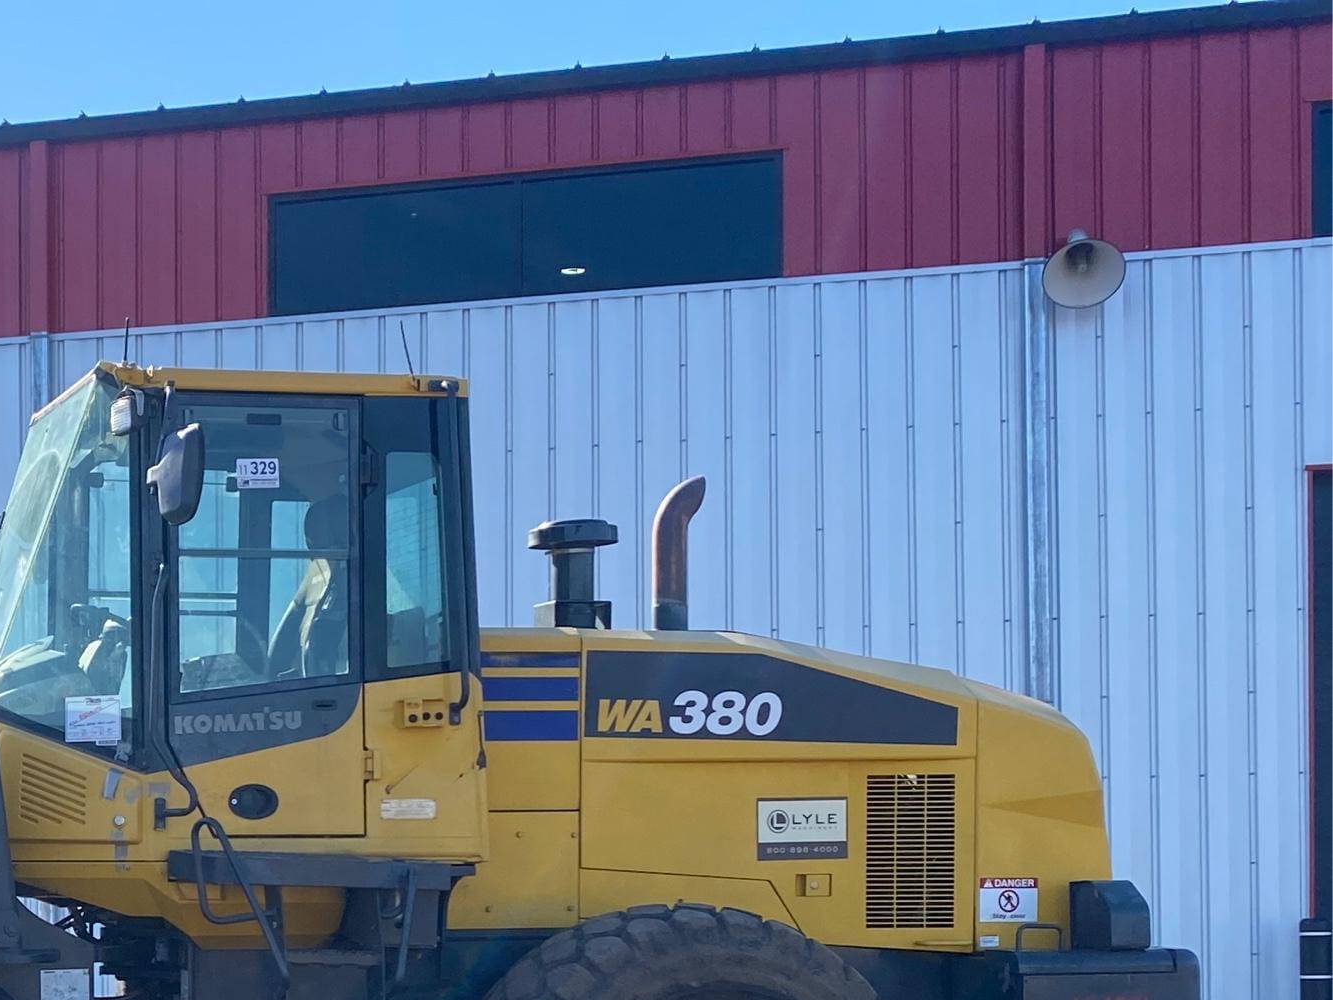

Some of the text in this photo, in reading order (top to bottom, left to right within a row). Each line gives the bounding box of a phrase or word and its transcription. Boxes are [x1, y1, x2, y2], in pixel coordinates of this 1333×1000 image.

[250, 461, 277, 475] 329
[597, 690, 782, 736] WA 380
[174, 706, 302, 735] KOMATSU
[792, 813, 838, 825] LYLE
[994, 878, 1035, 888] DANGER
